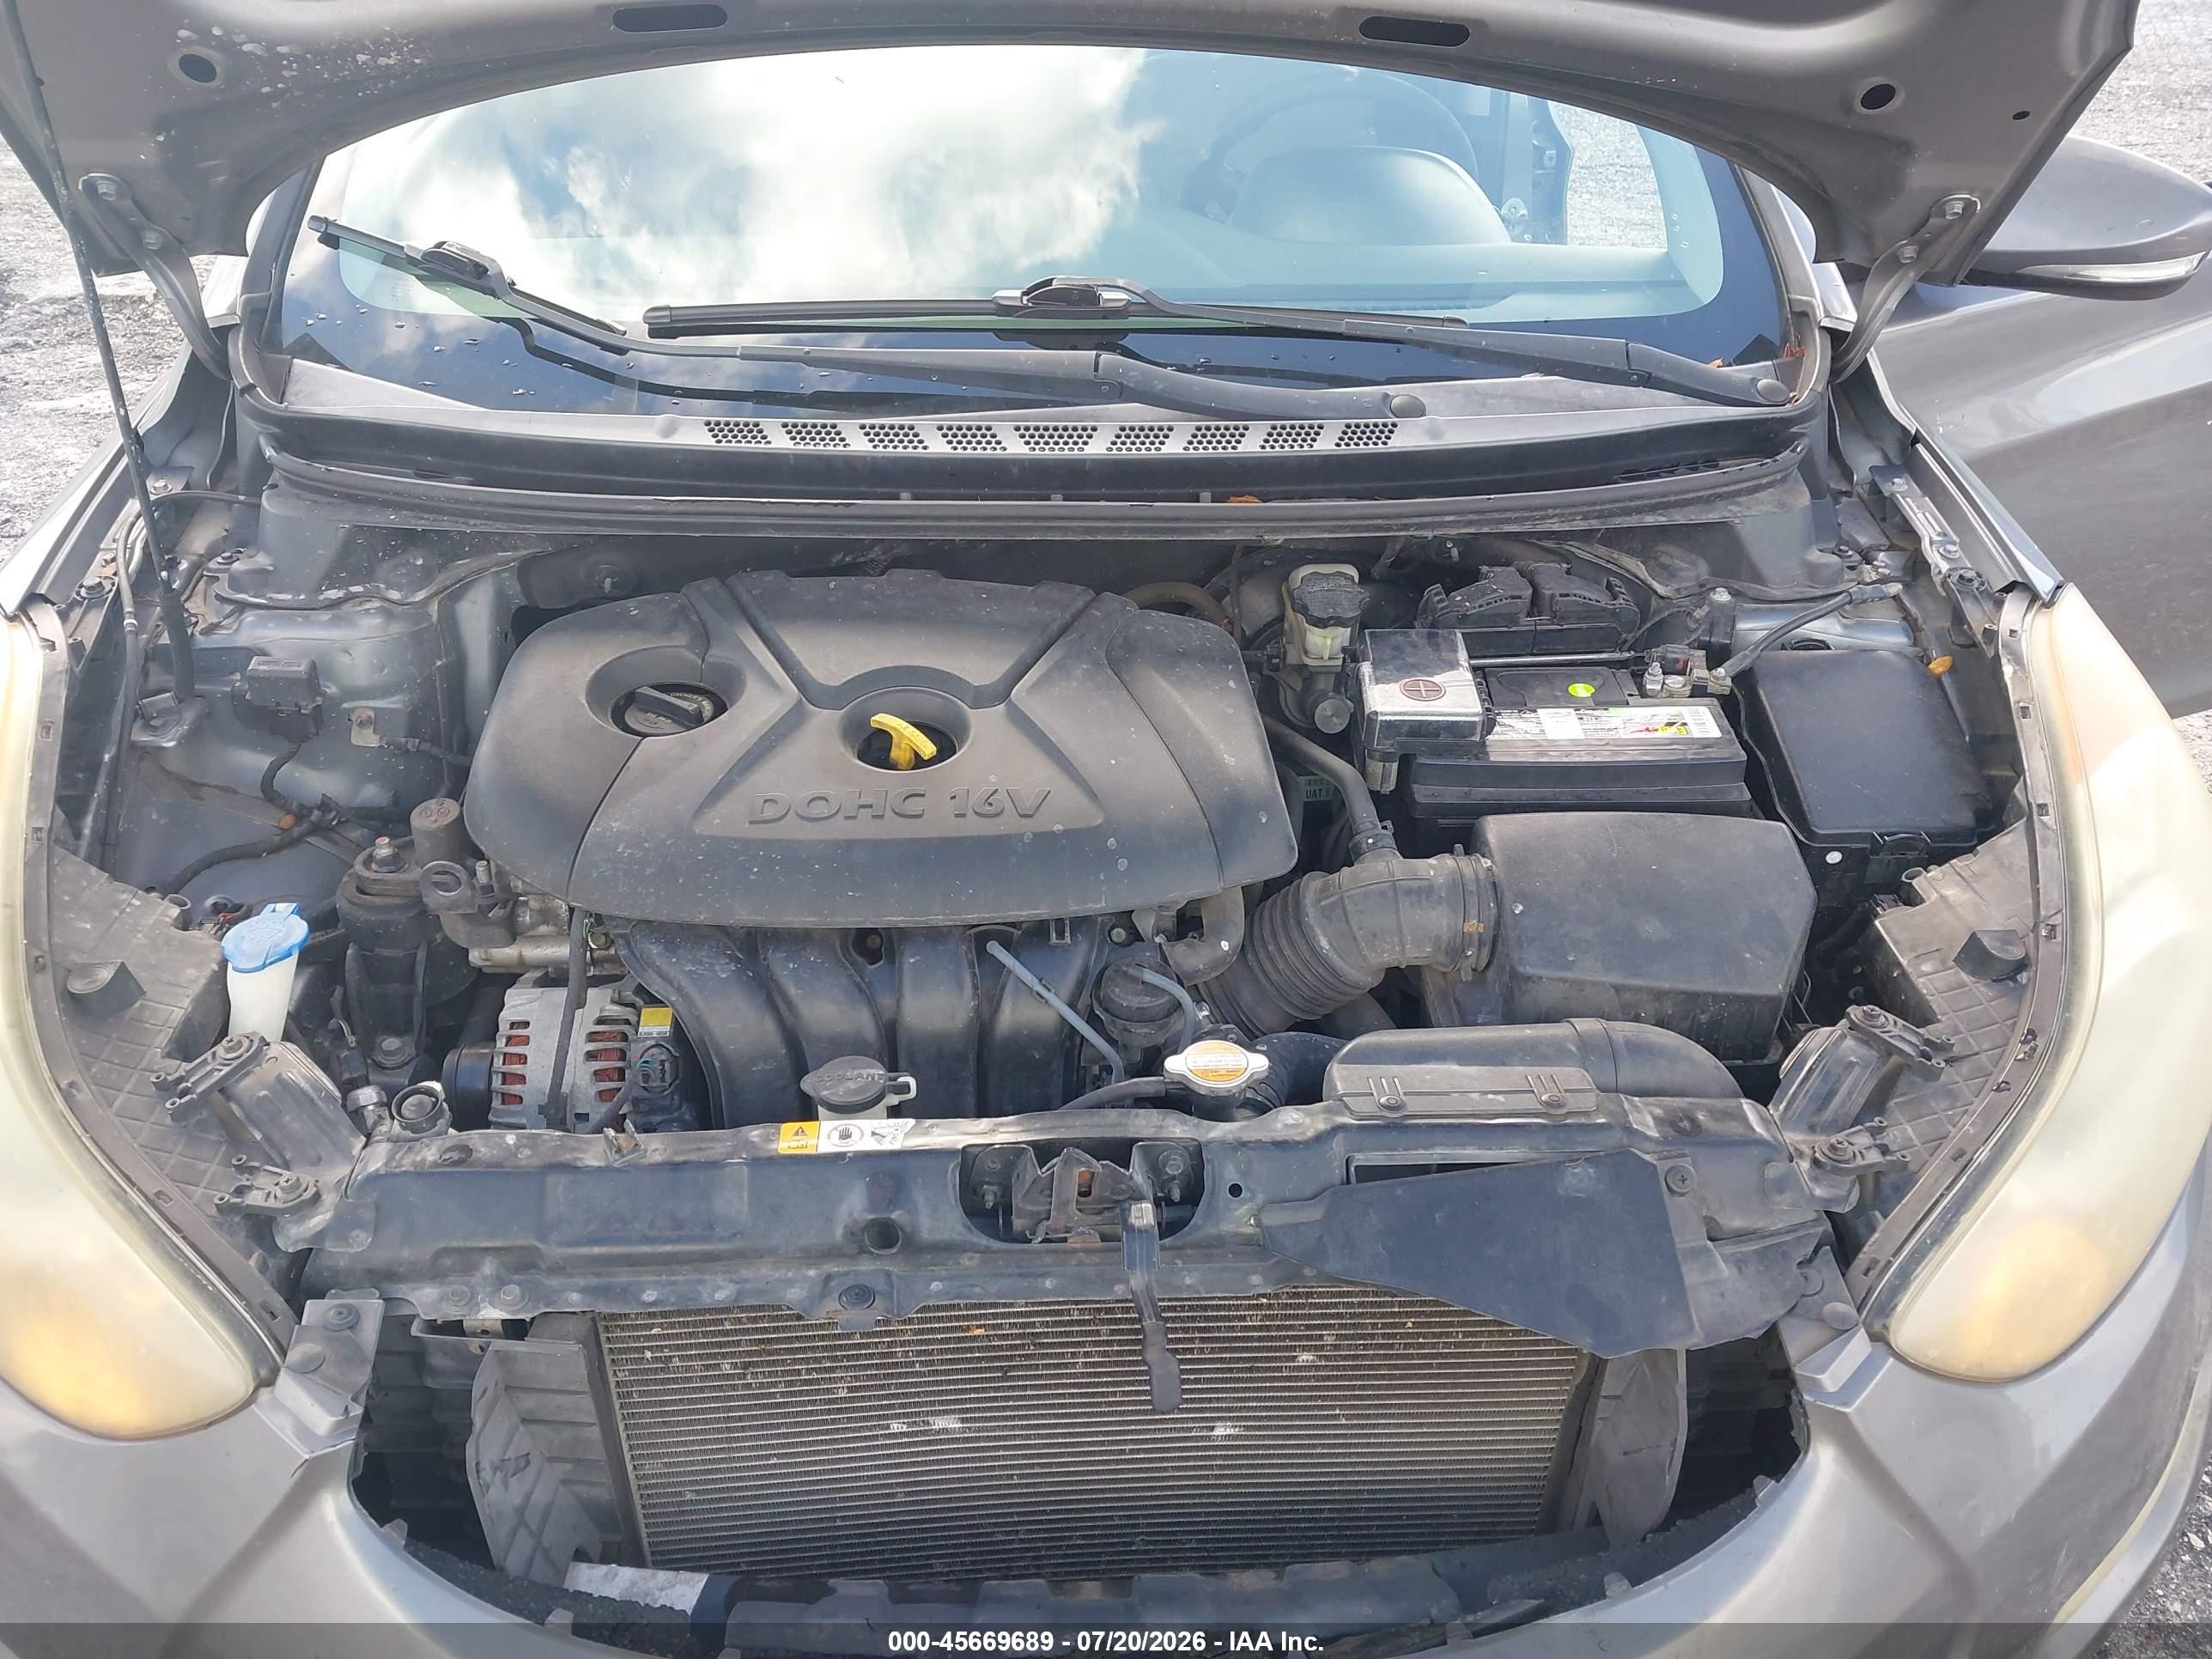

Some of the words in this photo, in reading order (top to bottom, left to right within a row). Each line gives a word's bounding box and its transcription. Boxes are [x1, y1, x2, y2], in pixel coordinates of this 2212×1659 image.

[748, 787, 926, 824] DOHC
[949, 785, 1051, 817] 16V
[815, 1069, 885, 1083] COOLANT
